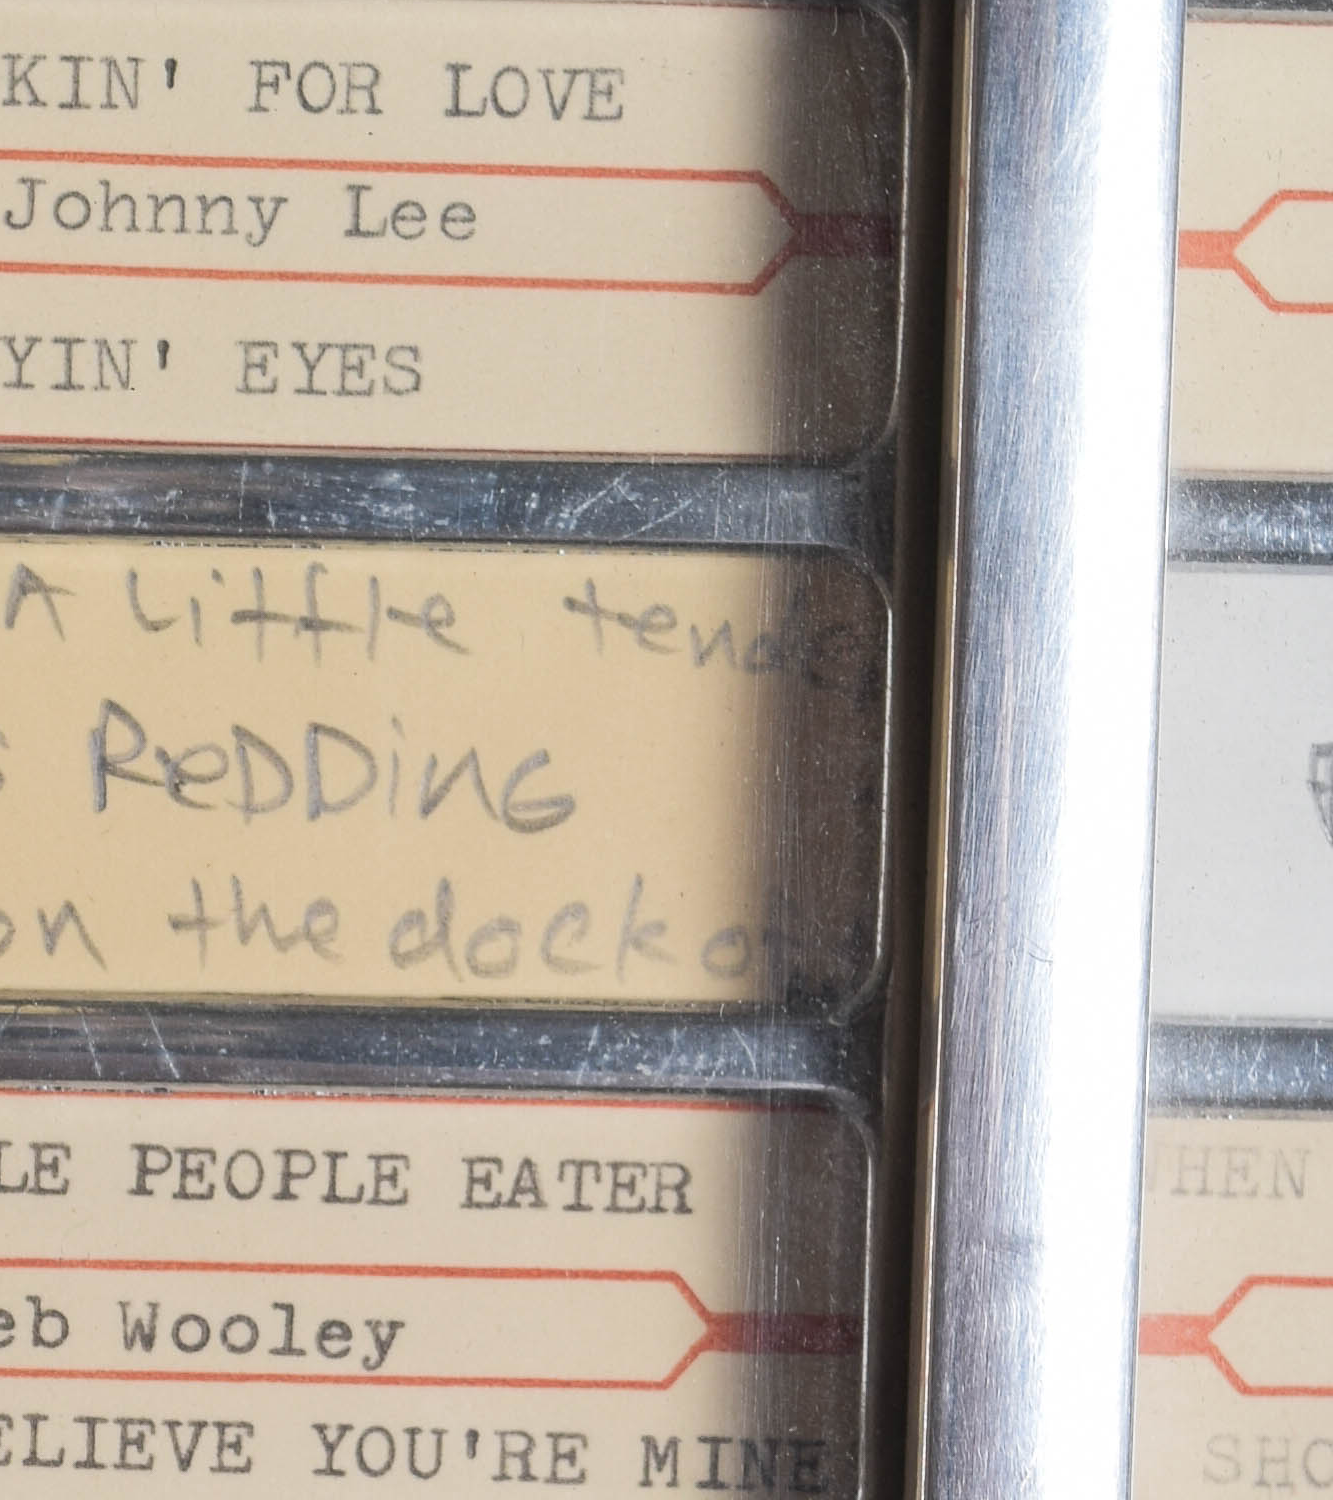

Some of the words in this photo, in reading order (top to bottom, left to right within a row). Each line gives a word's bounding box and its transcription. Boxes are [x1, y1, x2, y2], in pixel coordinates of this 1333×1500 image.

[247, 59, 383, 115] FOR
[444, 62, 624, 122] LOVE
[3, 176, 289, 248] Johnny
[344, 184, 477, 241] Lee
[235, 340, 422, 397] EYES
[127, 1143, 410, 1207] PEOPLE
[460, 1156, 694, 1215] EATER
[118, 1301, 406, 1372] Wooley
[311, 1423, 588, 1485] YOU'RE
[638, 1435, 825, 1491] MINE
